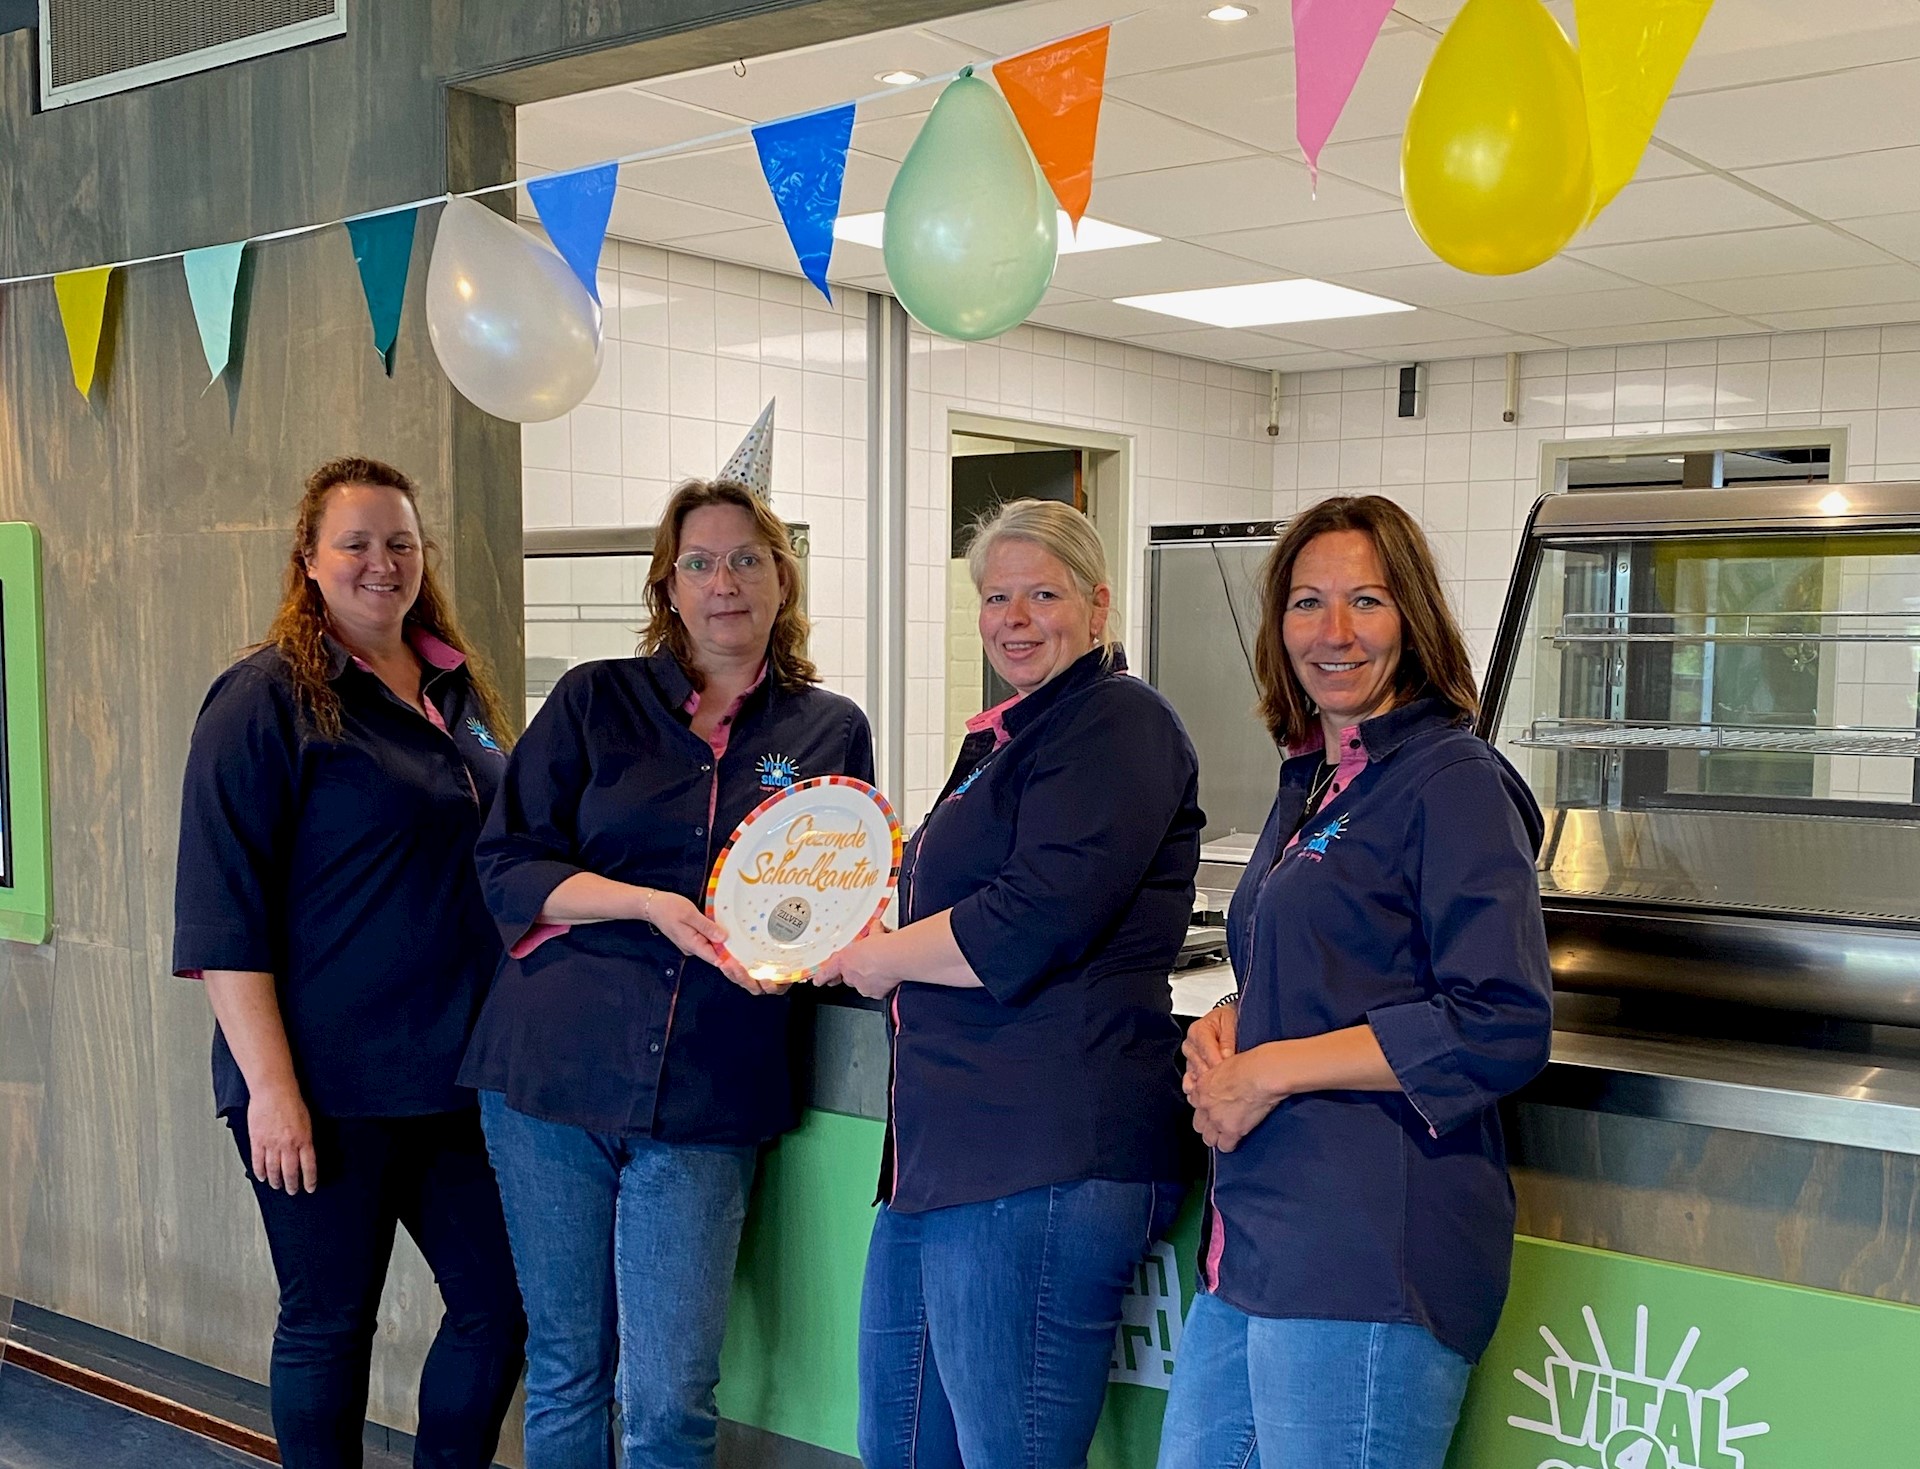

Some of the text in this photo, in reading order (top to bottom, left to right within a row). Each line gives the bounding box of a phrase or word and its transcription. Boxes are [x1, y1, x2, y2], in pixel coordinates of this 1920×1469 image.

[785, 814, 867, 860] Gezonde
[737, 850, 879, 892] Schoolkantine
[777, 909, 803, 928] ZILVER
